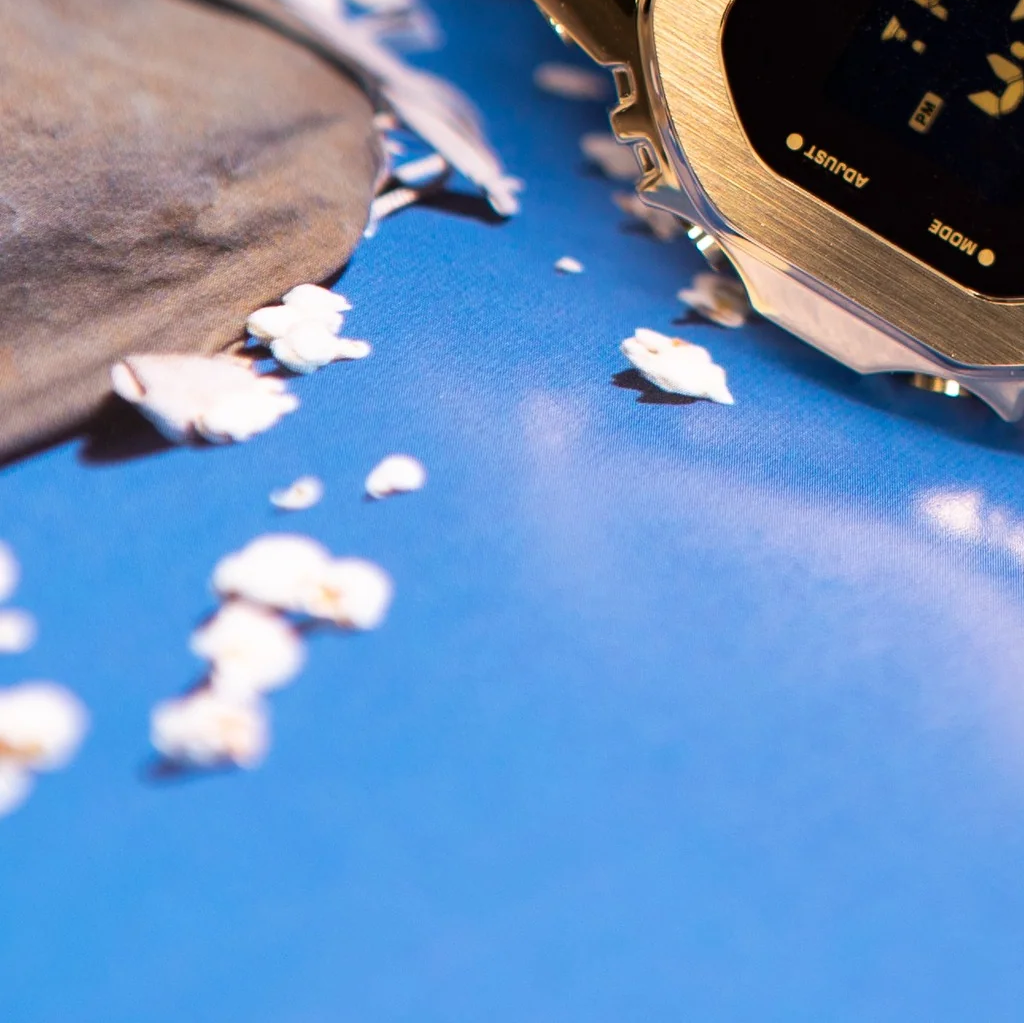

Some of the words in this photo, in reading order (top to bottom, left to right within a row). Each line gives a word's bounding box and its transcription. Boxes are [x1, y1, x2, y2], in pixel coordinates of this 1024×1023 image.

[915, 99, 937, 127] PM
[803, 144, 870, 189] ADJUST
[927, 218, 978, 256] MODE
